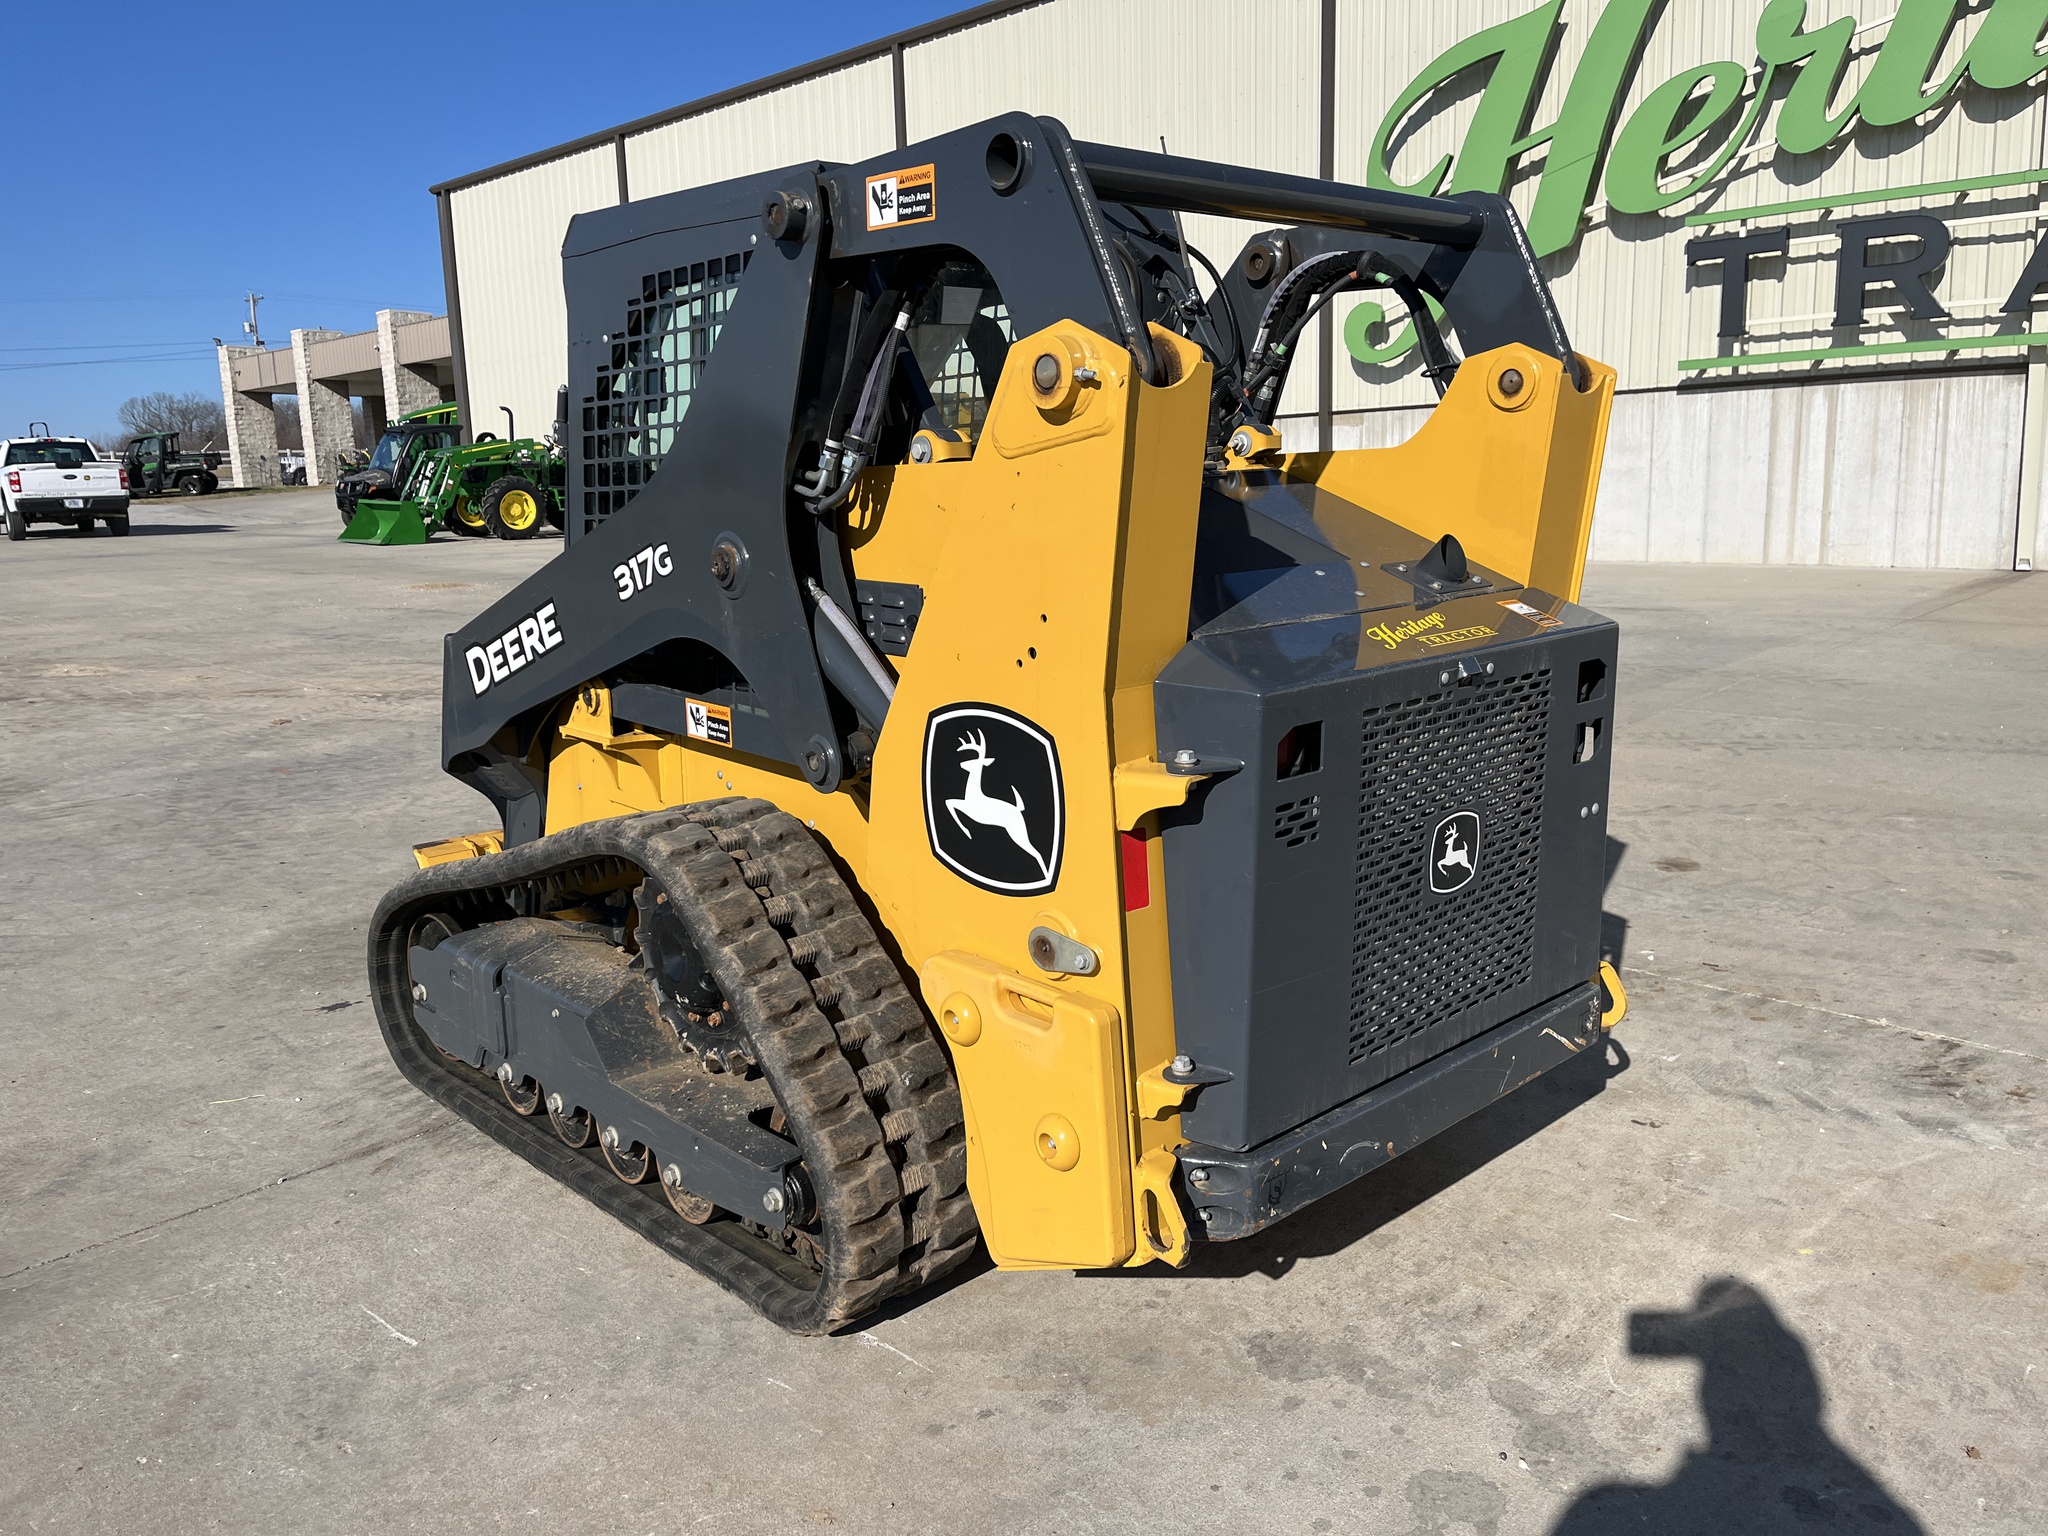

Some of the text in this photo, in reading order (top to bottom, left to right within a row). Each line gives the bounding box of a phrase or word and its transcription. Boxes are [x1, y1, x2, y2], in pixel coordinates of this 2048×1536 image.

[904, 171, 931, 183] WARNING
[898, 191, 931, 204] Pinch Area
[898, 205, 926, 215] Keep Away
[613, 543, 674, 601] 317G
[1366, 611, 1446, 650] Heritage
[1419, 627, 1495, 645] TRACTOR
[465, 601, 564, 695] DEERE
